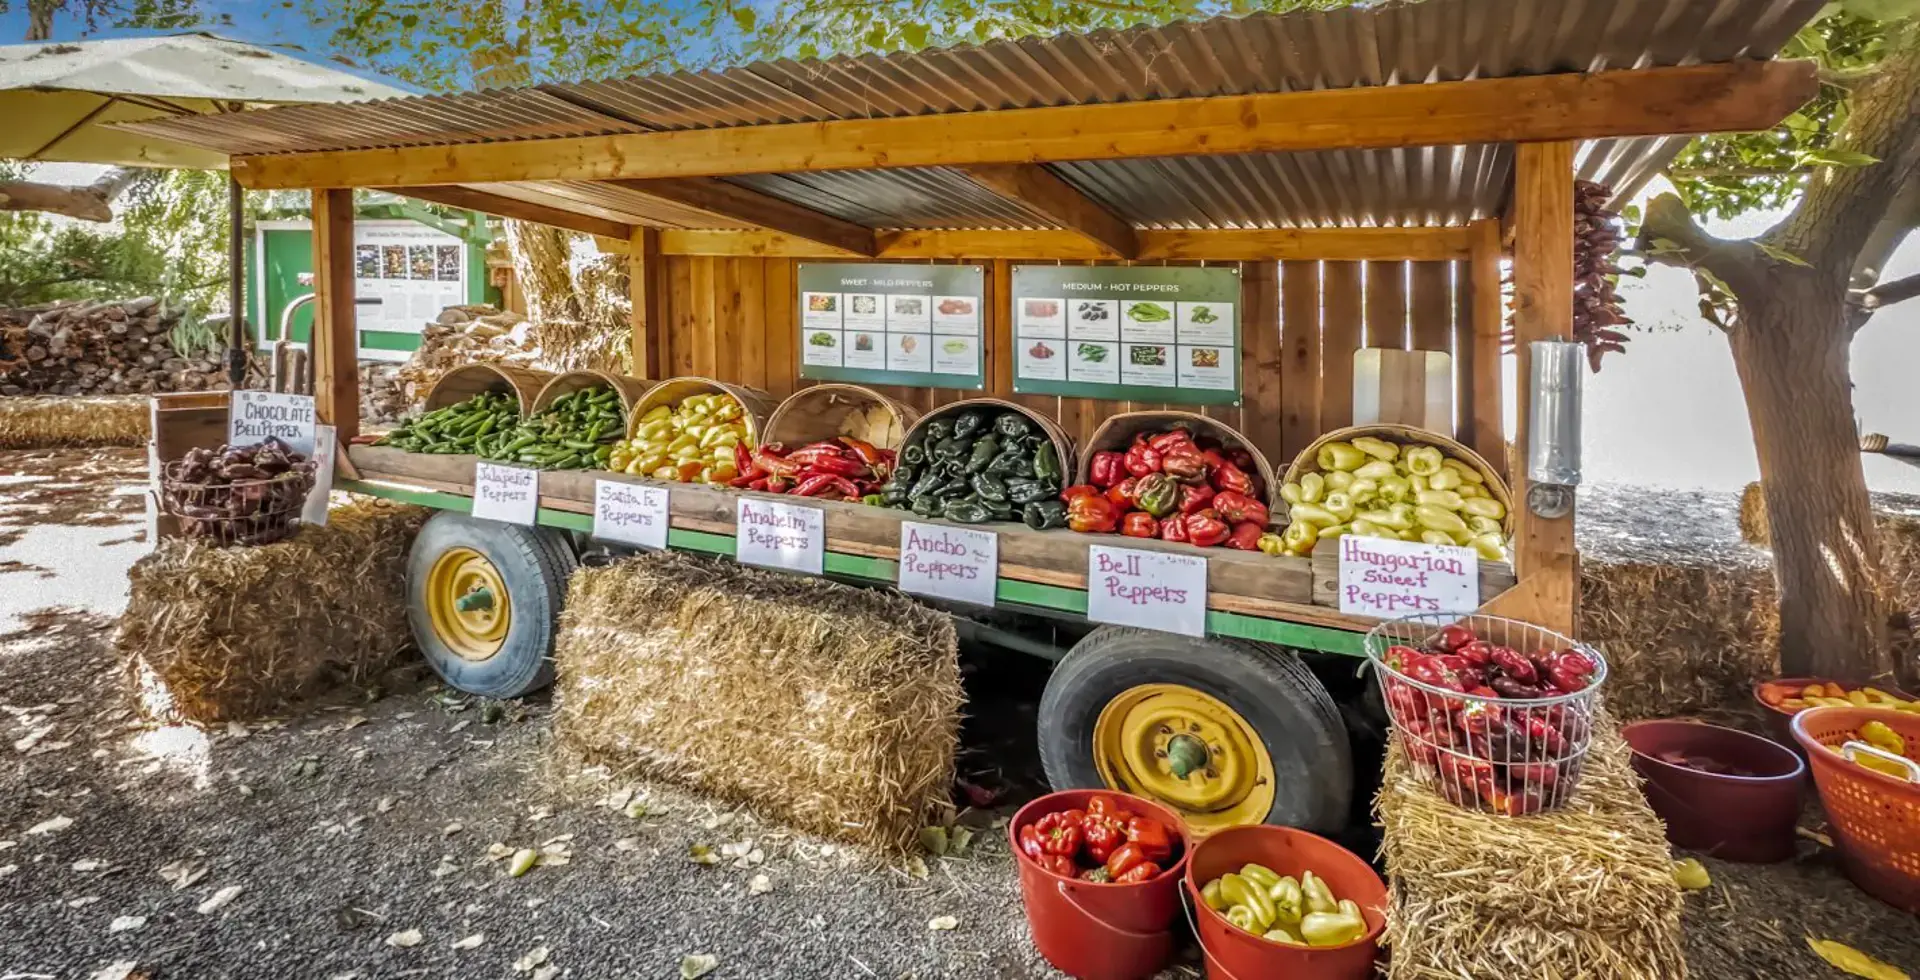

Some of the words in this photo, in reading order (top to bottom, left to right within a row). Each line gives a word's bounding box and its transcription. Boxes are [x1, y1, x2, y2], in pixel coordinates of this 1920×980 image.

[841, 278, 868, 286] SWEET
[874, 279, 894, 287] MILD
[895, 279, 934, 288] PEPPERS
[1133, 284, 1180, 293] PEPPERS
[245, 402, 312, 423] CHOCOLATE
[482, 486, 527, 502] Peppers
[600, 486, 641, 506] Santa
[643, 490, 658, 507] Fe
[600, 504, 653, 526] Peppers
[741, 504, 807, 532] Anaheim
[748, 527, 809, 549] Peppers
[907, 529, 967, 557] Ancho
[904, 553, 980, 580] Peppers
[1097, 553, 1141, 576] Bell
[1344, 539, 1466, 576] Hungarian
[1104, 575, 1188, 604] Peppers
[1346, 584, 1440, 611] Peppers
